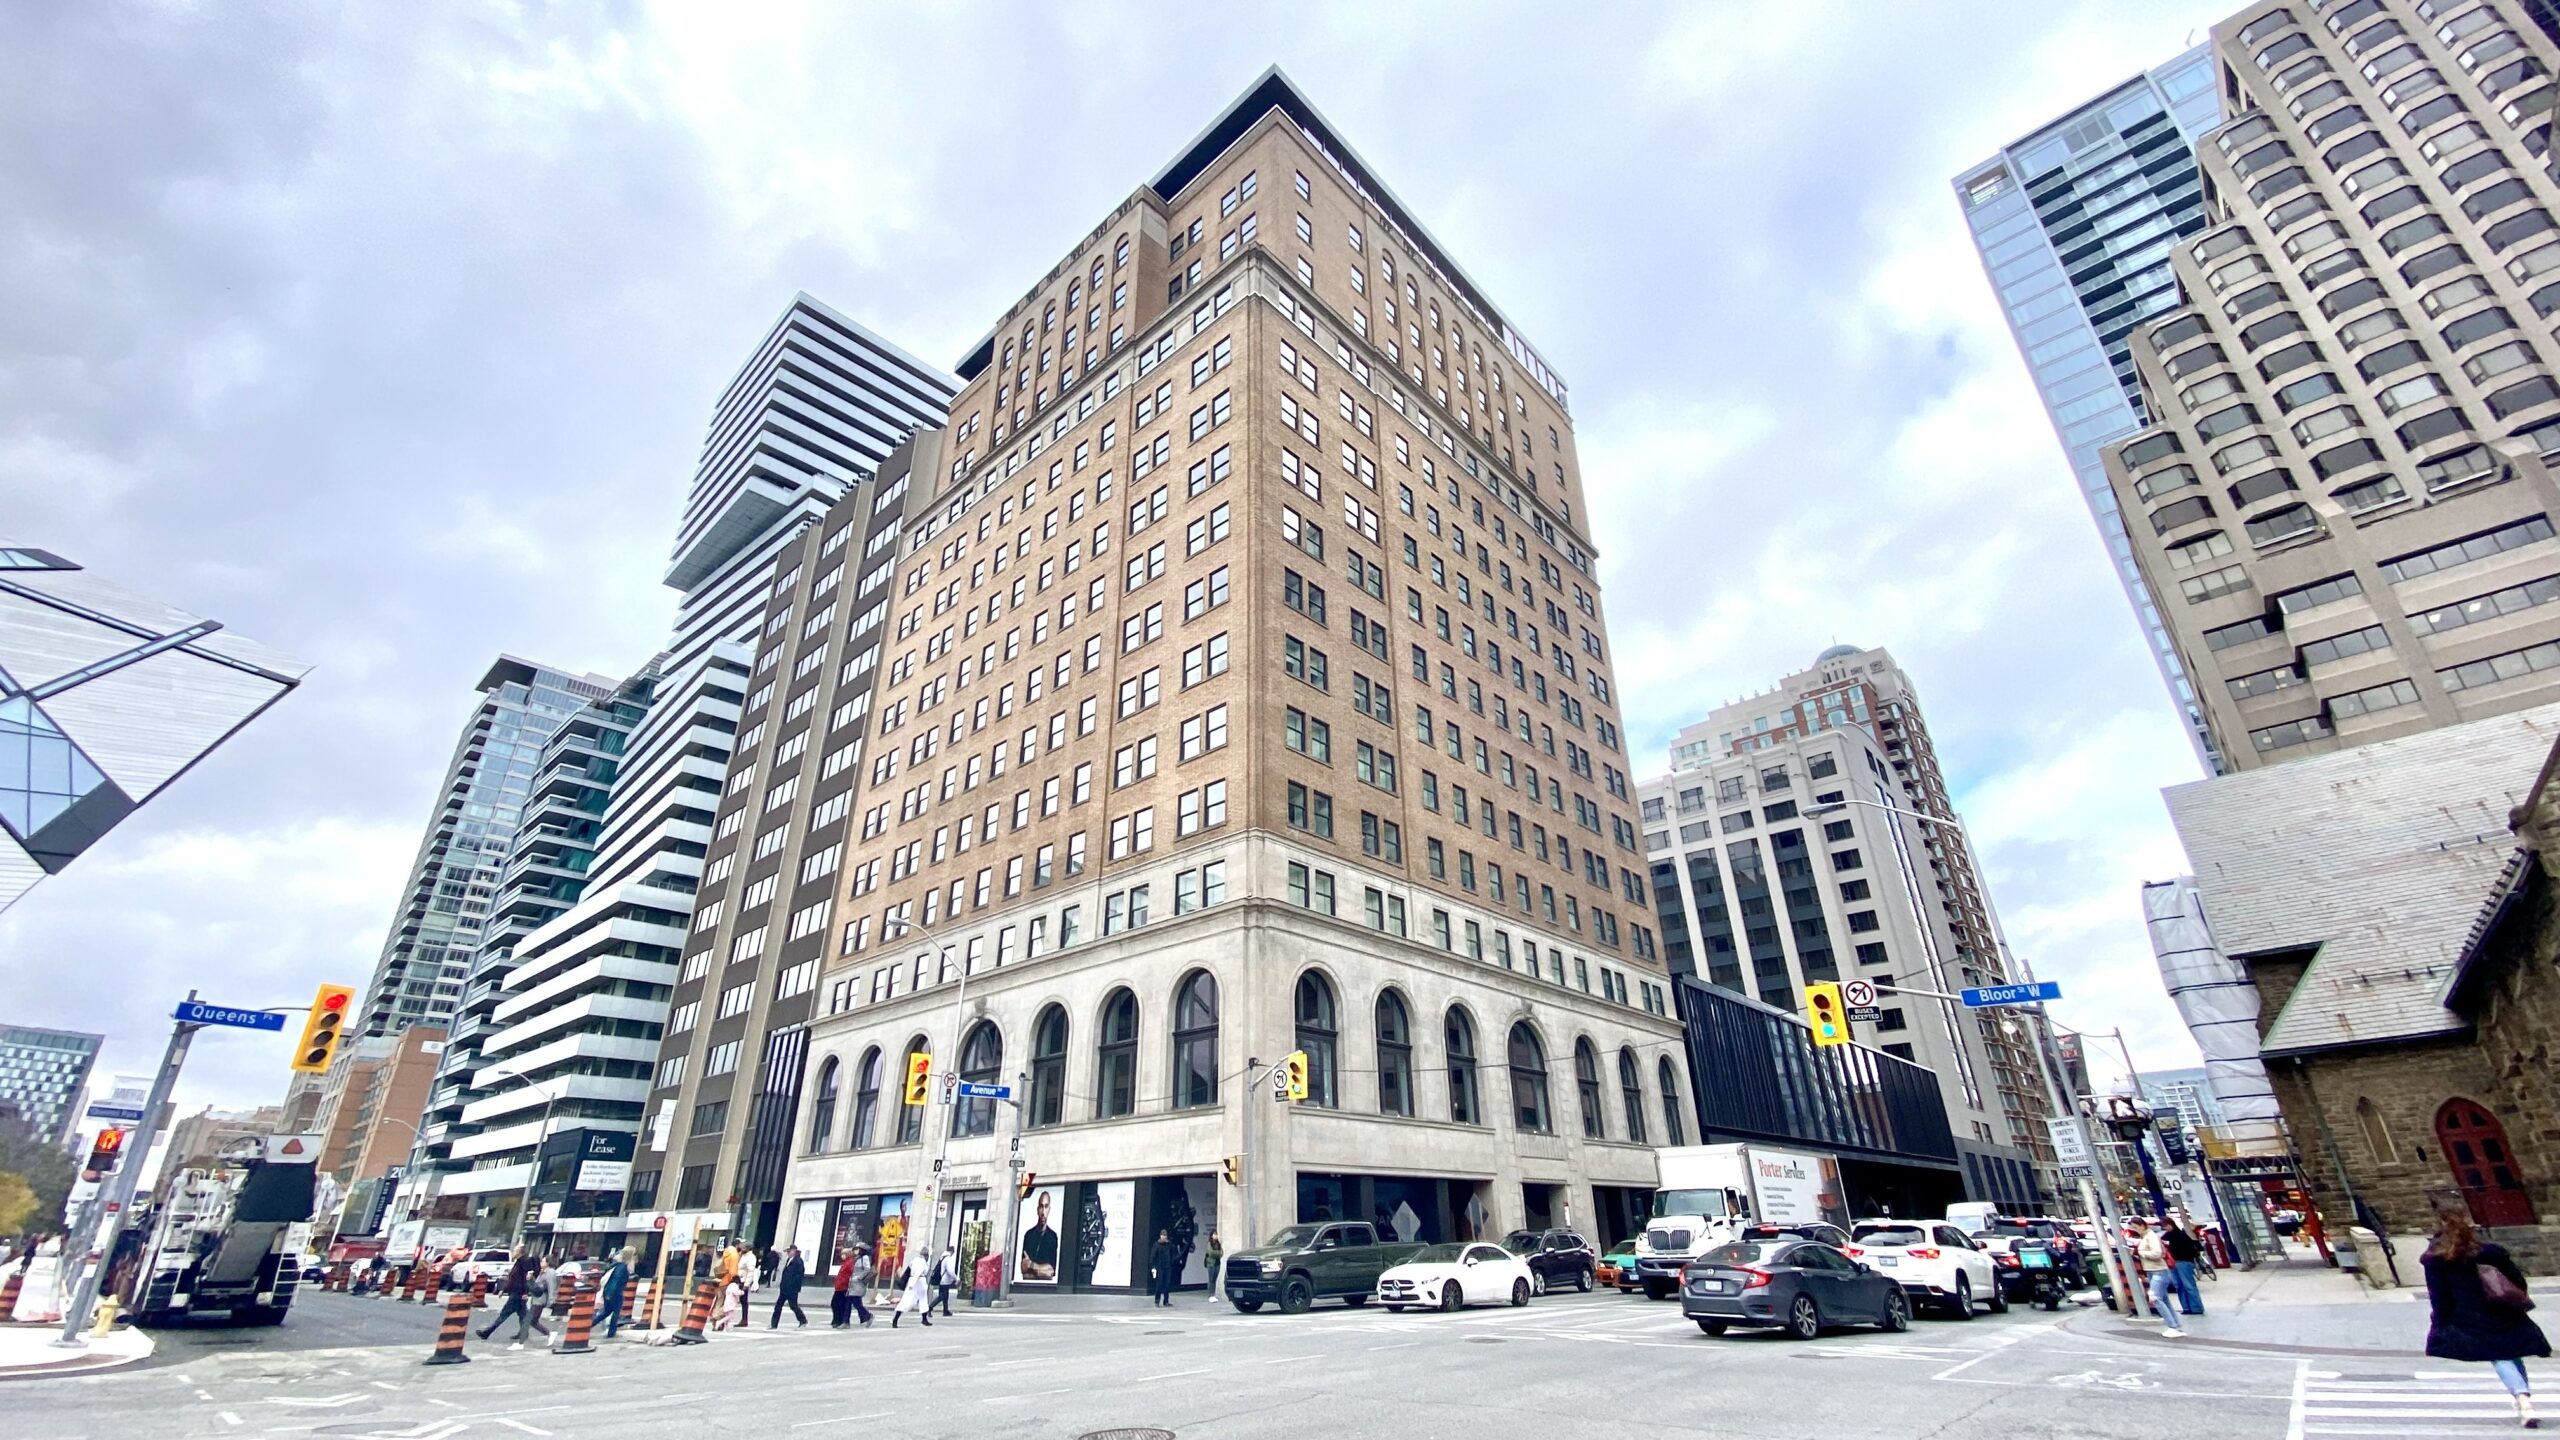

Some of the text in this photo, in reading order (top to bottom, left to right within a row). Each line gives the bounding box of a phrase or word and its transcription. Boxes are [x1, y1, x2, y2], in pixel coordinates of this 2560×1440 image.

[1979, 988, 2016, 1002] Bloor
[2027, 984, 2041, 998] W
[191, 1005, 257, 1024] Queens
[970, 1085, 996, 1095] Avenue
[2055, 1128, 2074, 1136] SAFETY
[591, 1135, 607, 1145] For
[589, 1145, 616, 1154] Lease
[1758, 1159, 1806, 1180] Porter Services
[2062, 1167, 2093, 1177] BEGINS
[2163, 1179, 2182, 1192] 40
